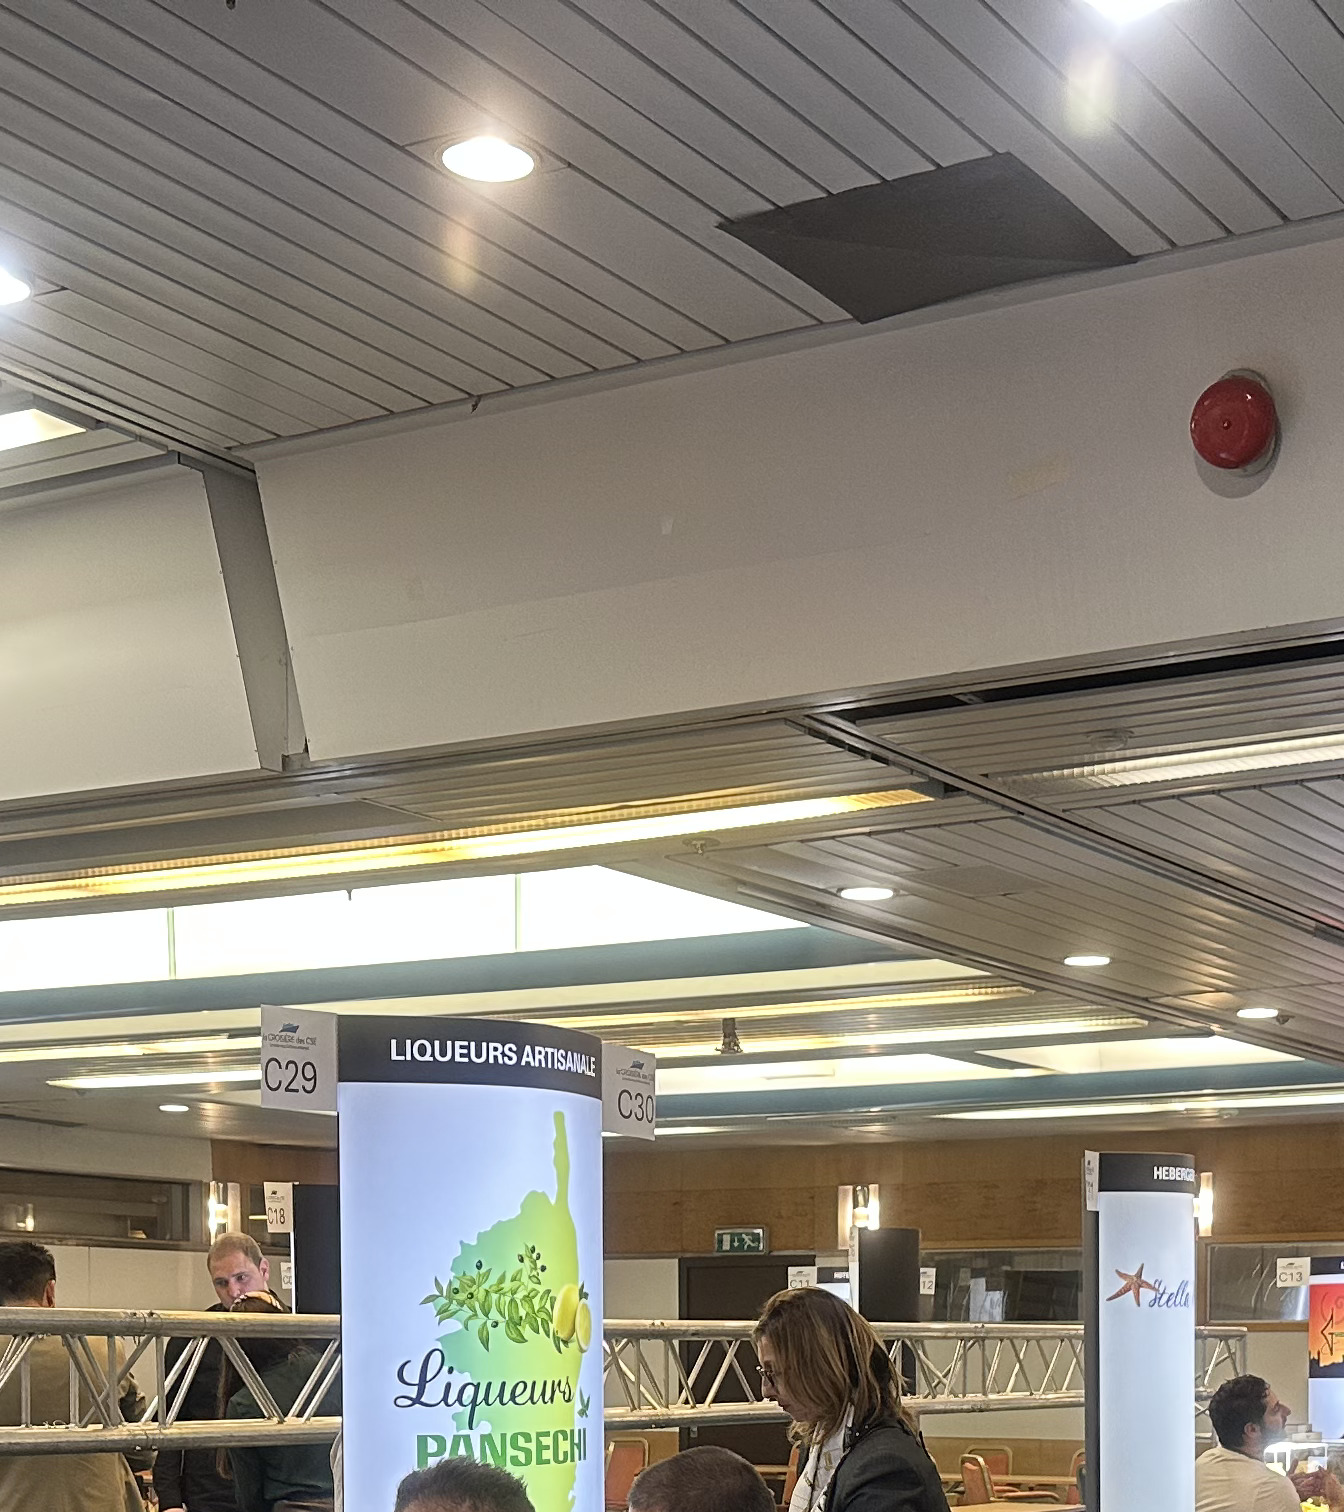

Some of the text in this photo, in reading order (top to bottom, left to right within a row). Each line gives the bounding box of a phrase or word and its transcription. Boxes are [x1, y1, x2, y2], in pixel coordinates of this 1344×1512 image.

[390, 1038, 517, 1066] LIQUEURS
[265, 1057, 317, 1094] C29
[618, 1089, 654, 1123] C30
[268, 1207, 286, 1225] C18
[922, 1281, 934, 1290] 12
[1279, 1272, 1303, 1282] C13
[393, 1347, 574, 1430] Liqueurs
[416, 1428, 587, 1468] PANSECHI
